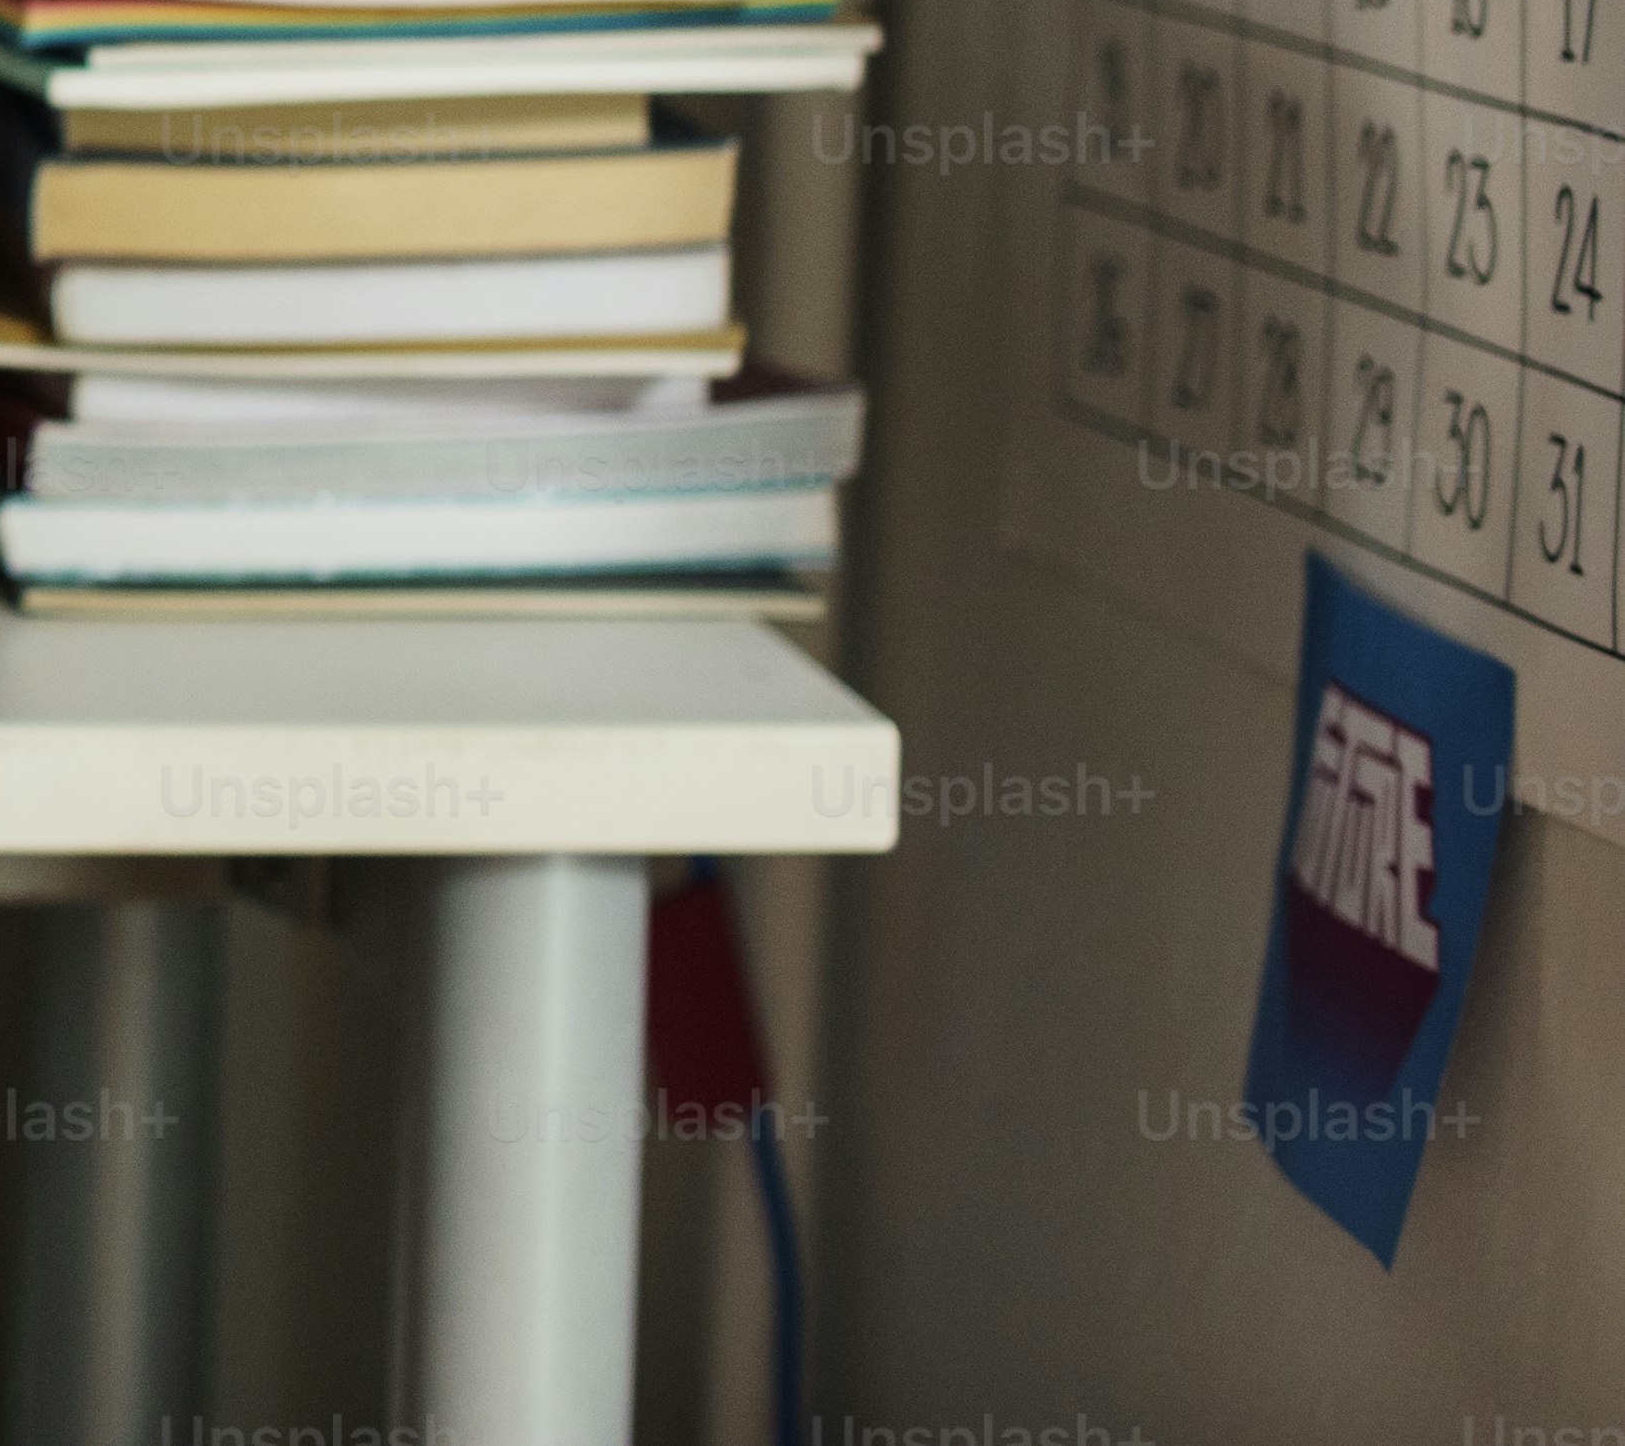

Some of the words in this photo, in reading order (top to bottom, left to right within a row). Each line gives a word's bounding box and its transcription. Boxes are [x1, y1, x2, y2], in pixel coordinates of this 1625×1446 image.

[1444, 149, 1499, 287] 23
[1550, 182, 1603, 322] 24
[1437, 388, 1492, 532] 30
[1537, 430, 1588, 576] 31
